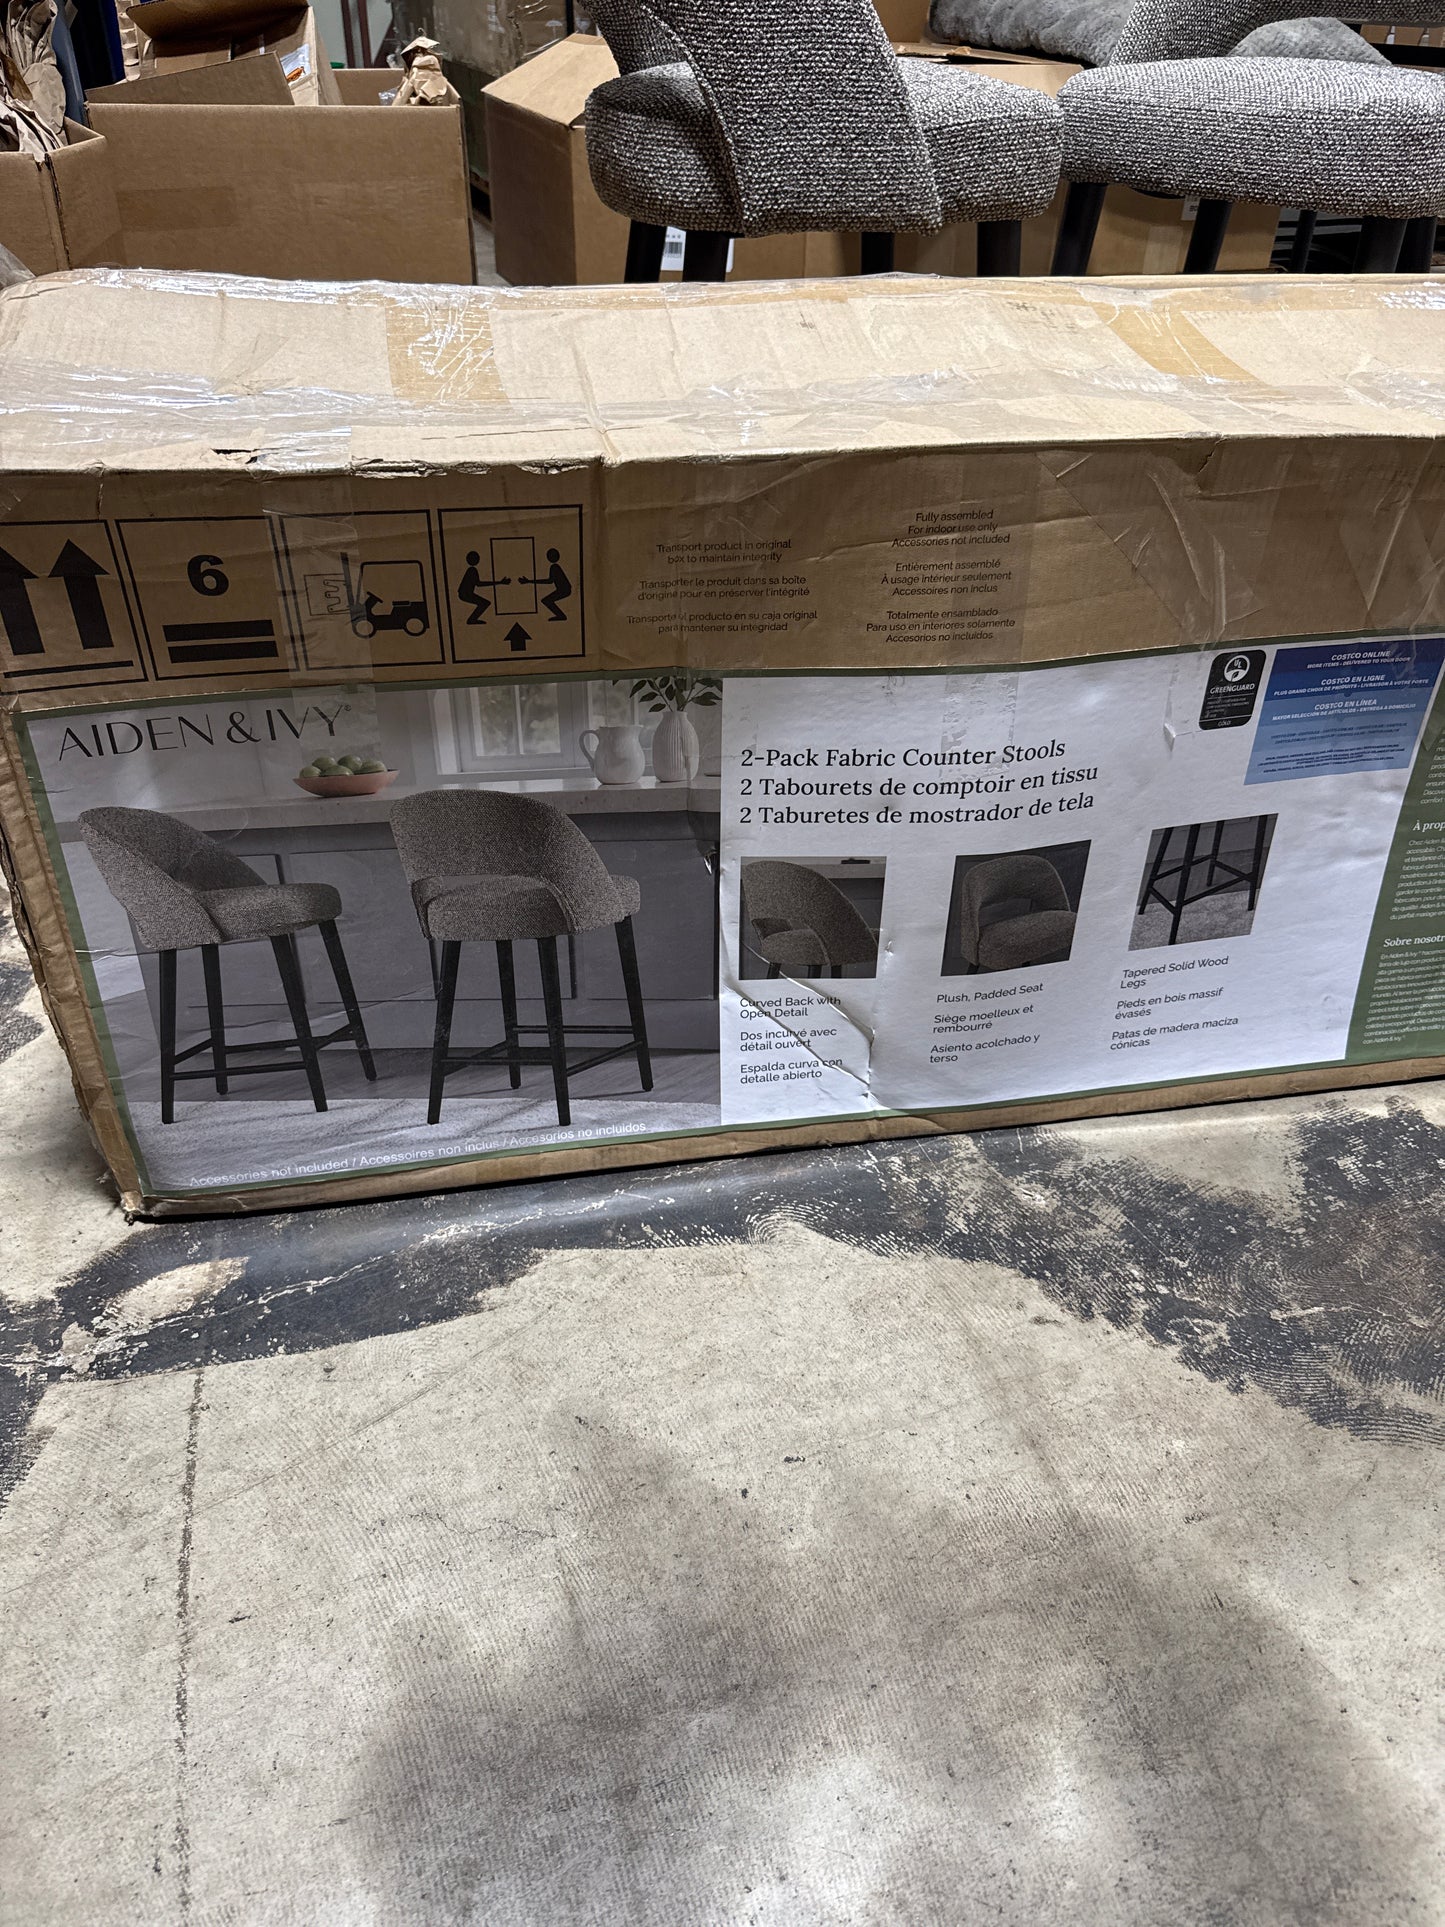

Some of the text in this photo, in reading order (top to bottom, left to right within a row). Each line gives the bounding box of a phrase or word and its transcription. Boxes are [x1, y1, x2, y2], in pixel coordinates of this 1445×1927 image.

[916, 510, 993, 523] Fully assembled
[908, 526, 922, 534] For
[926, 524, 956, 534] indoor
[978, 522, 998, 533] only
[656, 542, 700, 552] Transport
[704, 542, 742, 552] product
[756, 540, 792, 550] original
[892, 534, 1010, 547] Accessories not included
[668, 552, 782, 564] box to maintain integrity
[896, 559, 1000, 572] Entièrement assemblé
[187, 555, 229, 596] 6
[881, 572, 1011, 585] À usage intérieur seulement
[640, 578, 693, 590] Transporter
[695, 578, 704, 586] le
[707, 577, 741, 587] produit
[743, 577, 765, 585] dans
[782, 575, 806, 585] boîte
[638, 590, 678, 601] d'origine
[680, 590, 701, 599] pour
[719, 588, 763, 599] préserver
[892, 588, 948, 596] Accessoires
[971, 584, 998, 593] inclus
[627, 614, 676, 625] Transporte
[689, 612, 731, 622] producto
[762, 612, 781, 621] caja
[783, 610, 817, 621] original
[887, 608, 998, 619] Totalmente ensamblado
[658, 625, 678, 633] para
[680, 624, 725, 632] mantener
[741, 622, 788, 633] integridad
[866, 623, 887, 631] Para
[922, 622, 964, 630] interiores
[967, 619, 1015, 628] solamente
[886, 634, 936, 642] Accesorios
[1332, 651, 1391, 661] COSTCO ONLINE
[1321, 676, 1350, 685] COSTCO
[1363, 674, 1386, 682] LIGNE
[1210, 684, 1255, 694] GREENGUARD
[1314, 702, 1343, 710] COSTCO
[1344, 700, 1354, 708] EN
[59, 714, 213, 761] AIDEN
[741, 739, 1065, 766] 2-Pack Fabric Counter Stools
[741, 767, 1098, 799] 2 Tabourets de comptoir en tissu
[740, 792, 1094, 823] 2 Taburetes de mostrador de tela
[1413, 820, 1420, 830] À
[1384, 938, 1412, 948] Sobre
[1123, 956, 1228, 978] Tapered Solid Wood
[1121, 979, 1146, 989] Legs
[974, 987, 1016, 1000] Padded
[1019, 983, 1043, 994] Seat
[1117, 987, 1223, 1009] Pieds en bois massif
[740, 997, 841, 1007] Curved Back with
[740, 1008, 808, 1020] Open Detail
[934, 1005, 1034, 1024] Siège moelleux et
[1115, 1008, 1151, 1019] évasés
[933, 1021, 992, 1034] rembourré
[1112, 1016, 1238, 1040] Patas de madera maciza
[741, 1028, 837, 1041] Dos incurvé avec
[740, 1039, 811, 1051] détail ouvert
[931, 1034, 1040, 1053] Asiento acolchado y
[1110, 1038, 1150, 1050] cónicas
[930, 1054, 958, 1063] terso
[741, 1062, 785, 1074] Espalda
[788, 1060, 819, 1069] curva
[740, 1070, 822, 1084] detalle abierto
[190, 1170, 268, 1186] Accessories
[272, 1166, 292, 1176] not
[295, 1159, 348, 1173] included
[360, 1149, 434, 1166] Accessoires
[438, 1146, 460, 1156] non
[465, 1140, 499, 1152] inclus
[510, 1130, 574, 1146] Accesorios
[578, 1128, 592, 1137] no
